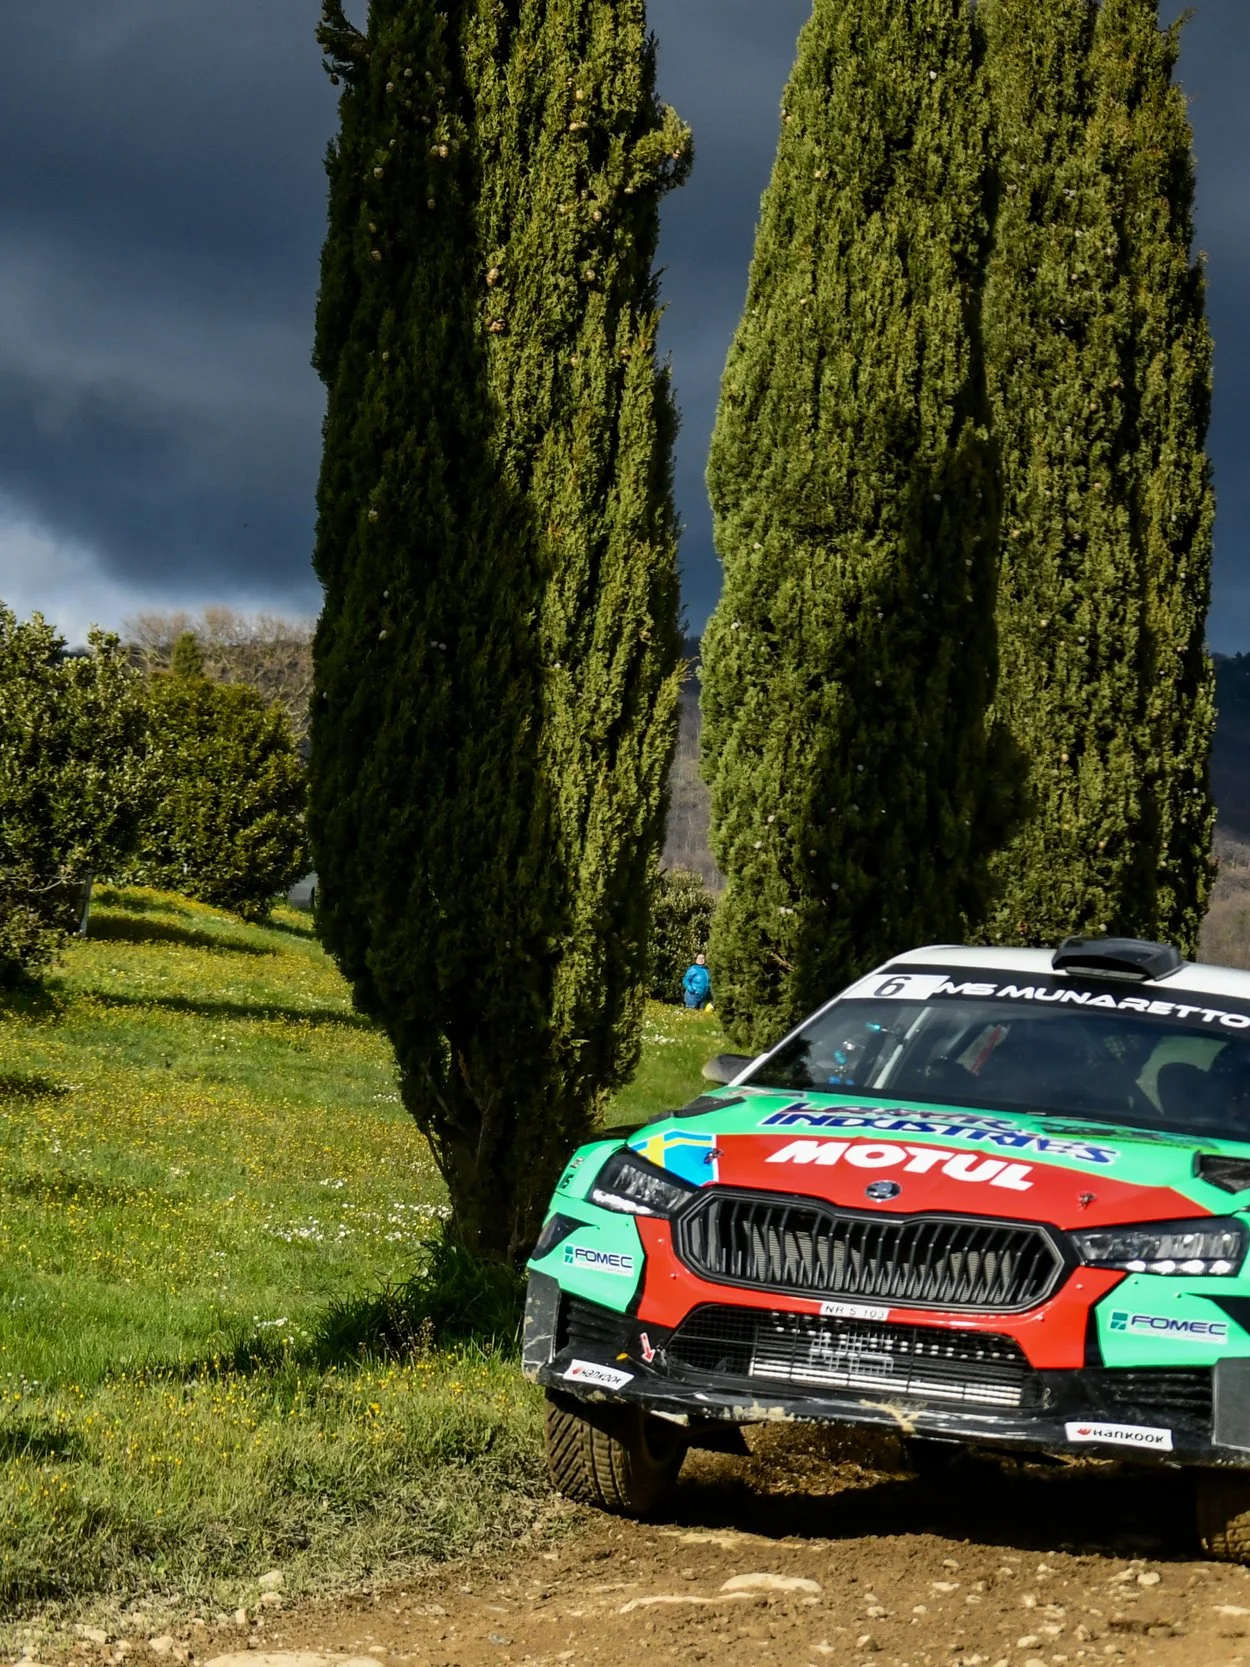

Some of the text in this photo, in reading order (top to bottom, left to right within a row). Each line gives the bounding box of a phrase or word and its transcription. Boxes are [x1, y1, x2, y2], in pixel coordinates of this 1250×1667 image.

[874, 976, 912, 997] 6
[760, 1113, 1117, 1163] INDUSTRIES
[764, 1140, 1035, 1191] MOTUL
[575, 1248, 633, 1269] FOMEC
[1131, 1315, 1227, 1336] FOMEC
